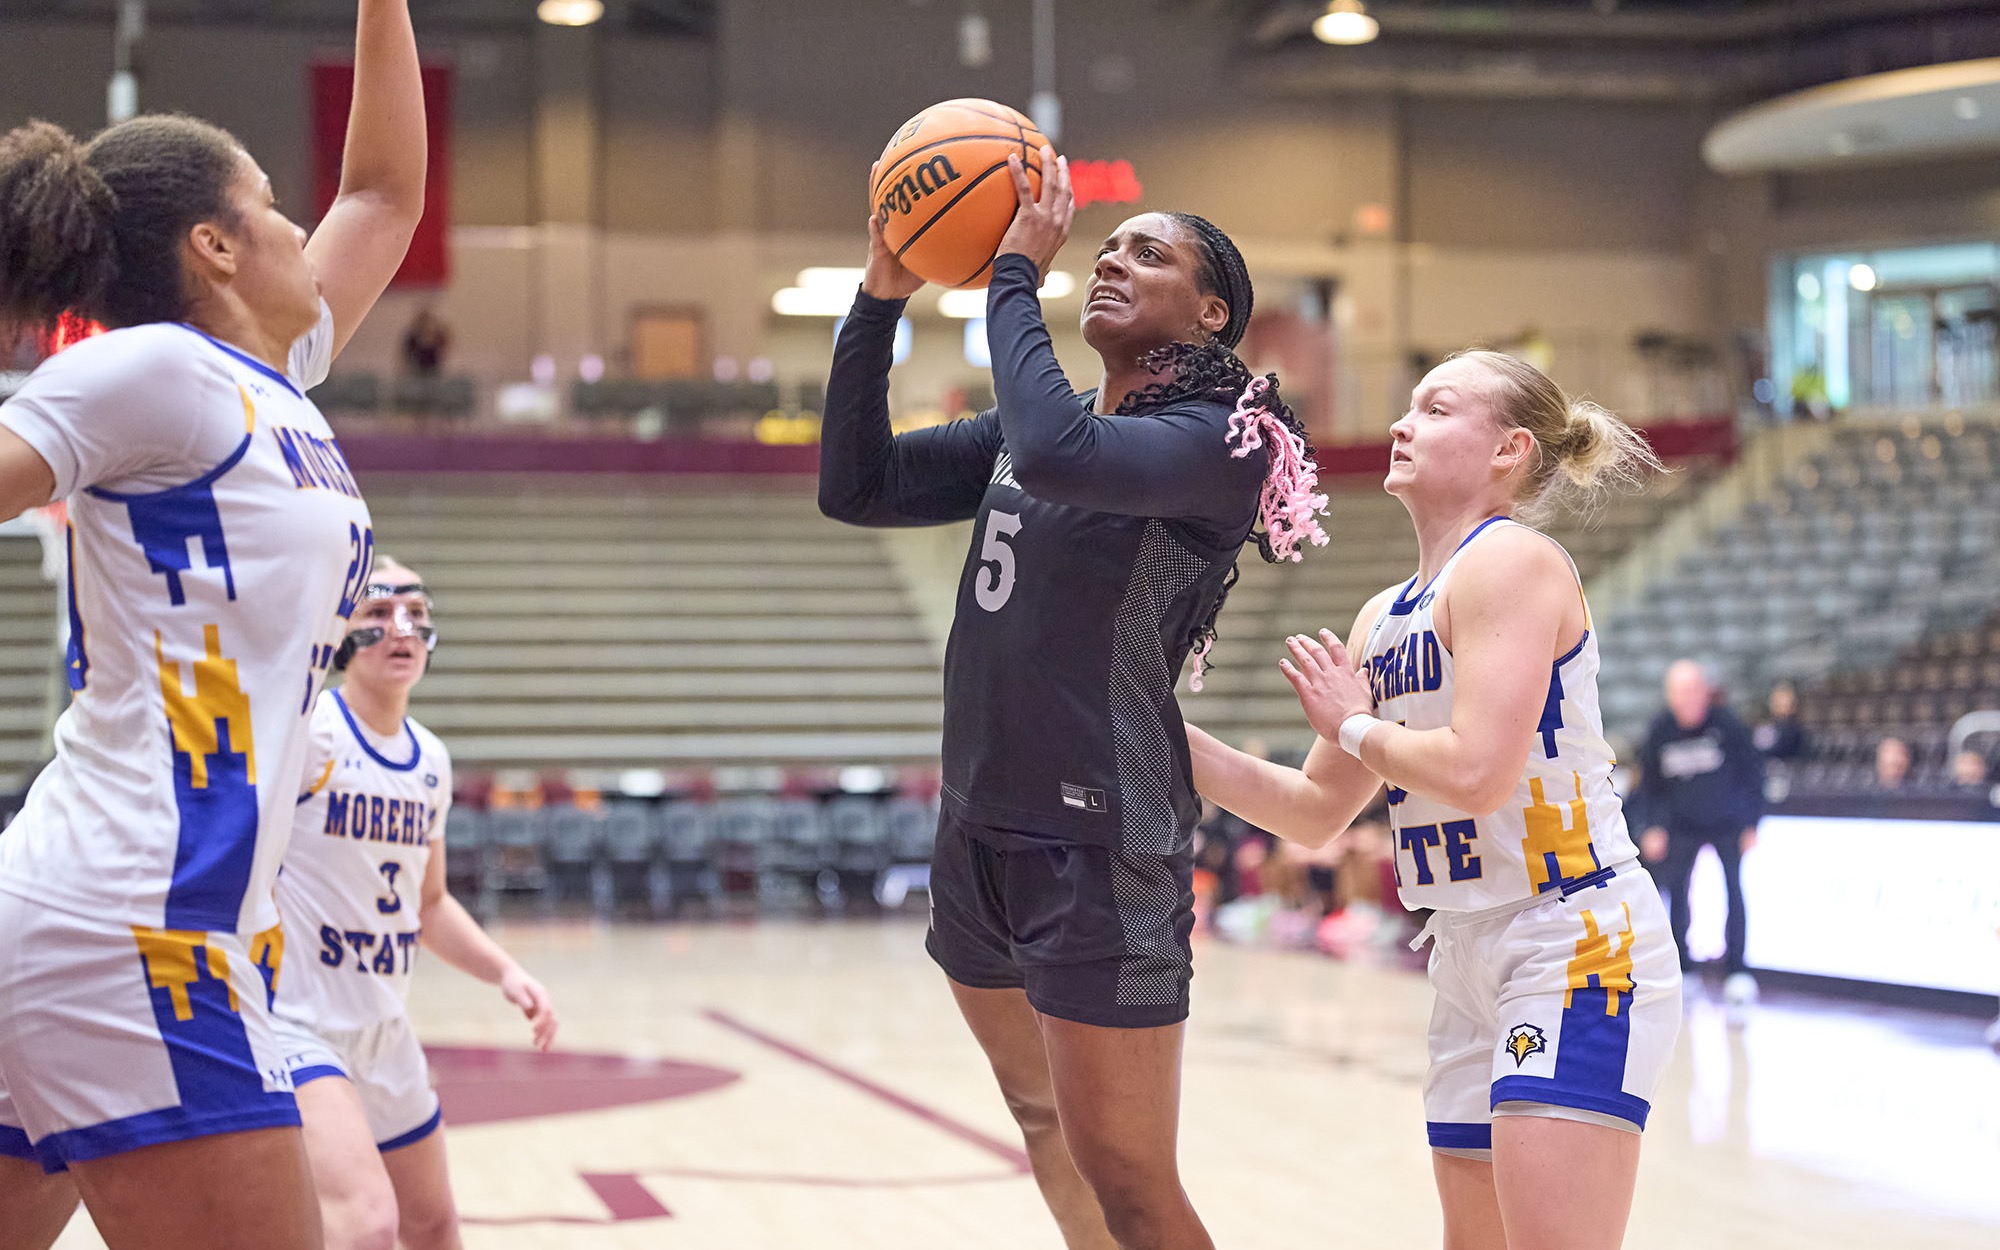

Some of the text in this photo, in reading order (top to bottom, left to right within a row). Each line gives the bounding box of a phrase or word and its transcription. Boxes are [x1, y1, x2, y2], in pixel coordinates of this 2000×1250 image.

[879, 154, 961, 228] Wilso
[975, 509, 1023, 612] 5
[1091, 795, 1098, 807] L
[1392, 818, 1482, 888] TE
[376, 861, 402, 915] 3
[318, 924, 422, 975] STAT
